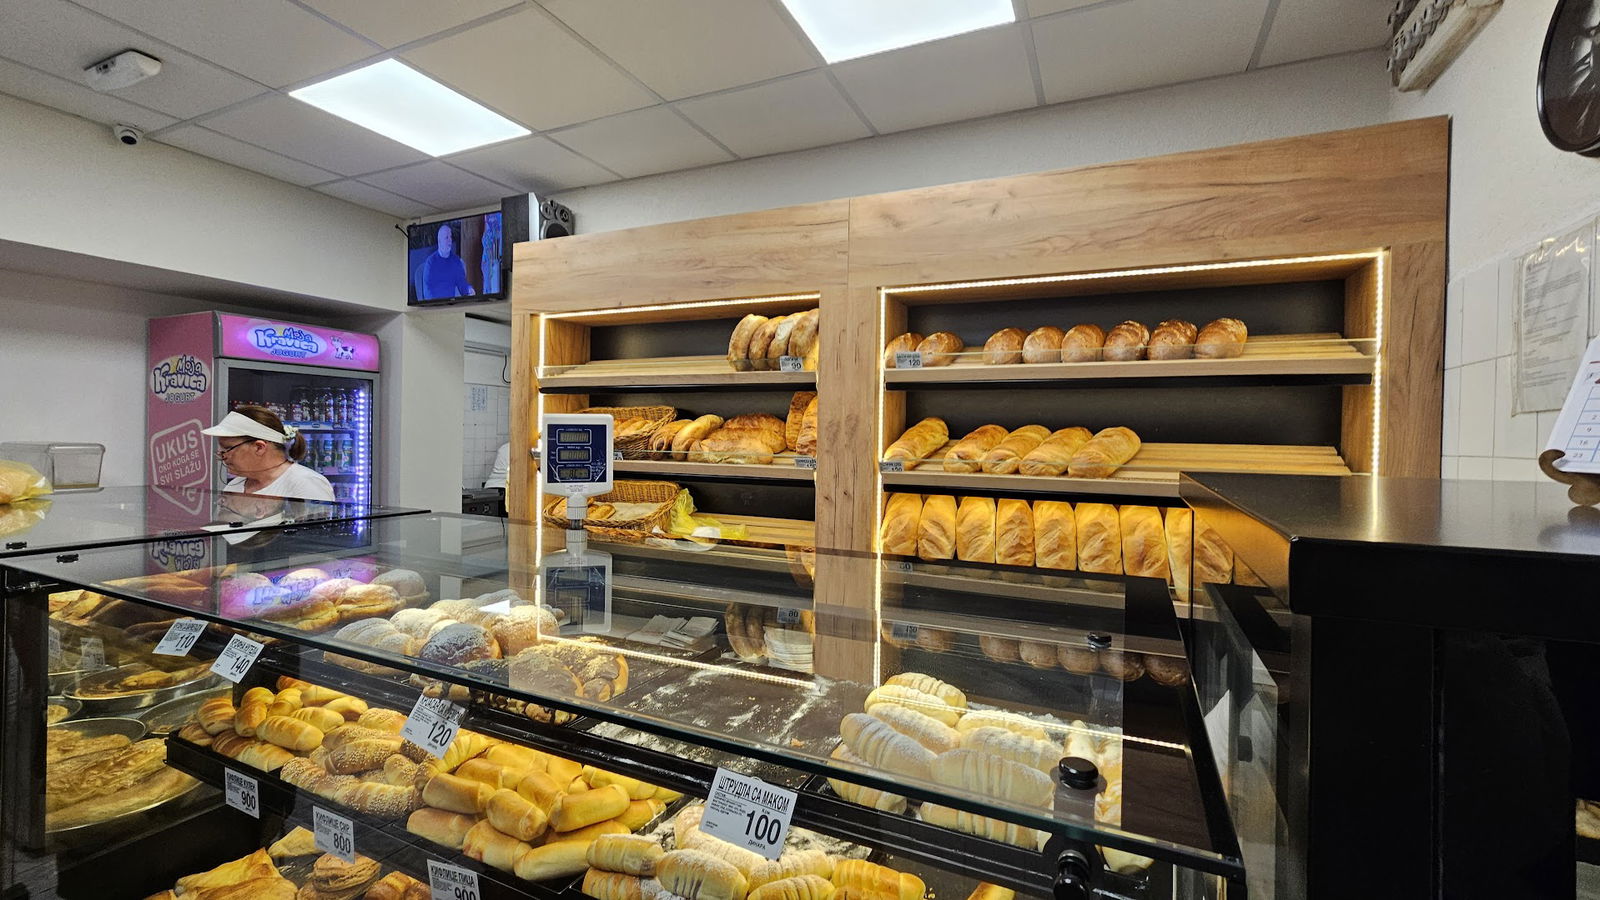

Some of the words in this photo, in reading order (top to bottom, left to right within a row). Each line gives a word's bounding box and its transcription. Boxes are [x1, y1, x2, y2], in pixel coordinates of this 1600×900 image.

[255, 328, 319, 353] Kravica
[283, 327, 312, 343] Moja
[271, 348, 307, 358] JOGURT
[909, 359, 920, 367] 120
[176, 354, 202, 376] Moja
[153, 362, 206, 394] Kravica
[156, 430, 198, 463] UKUS
[172, 453, 190, 467] KOGA
[190, 449, 200, 460] SE
[160, 474, 174, 486] SVI
[174, 461, 202, 480] SLAŽU
[175, 634, 196, 649] 110
[230, 655, 250, 674] 140
[427, 721, 452, 747] 120
[241, 791, 256, 810] 900
[718, 775, 752, 799] ШТРУДЛА
[751, 786, 763, 803] СА
[761, 790, 791, 813] МАКОМ
[744, 810, 782, 846] 100
[333, 833, 351, 854] 800
[454, 886, 478, 900] 900
